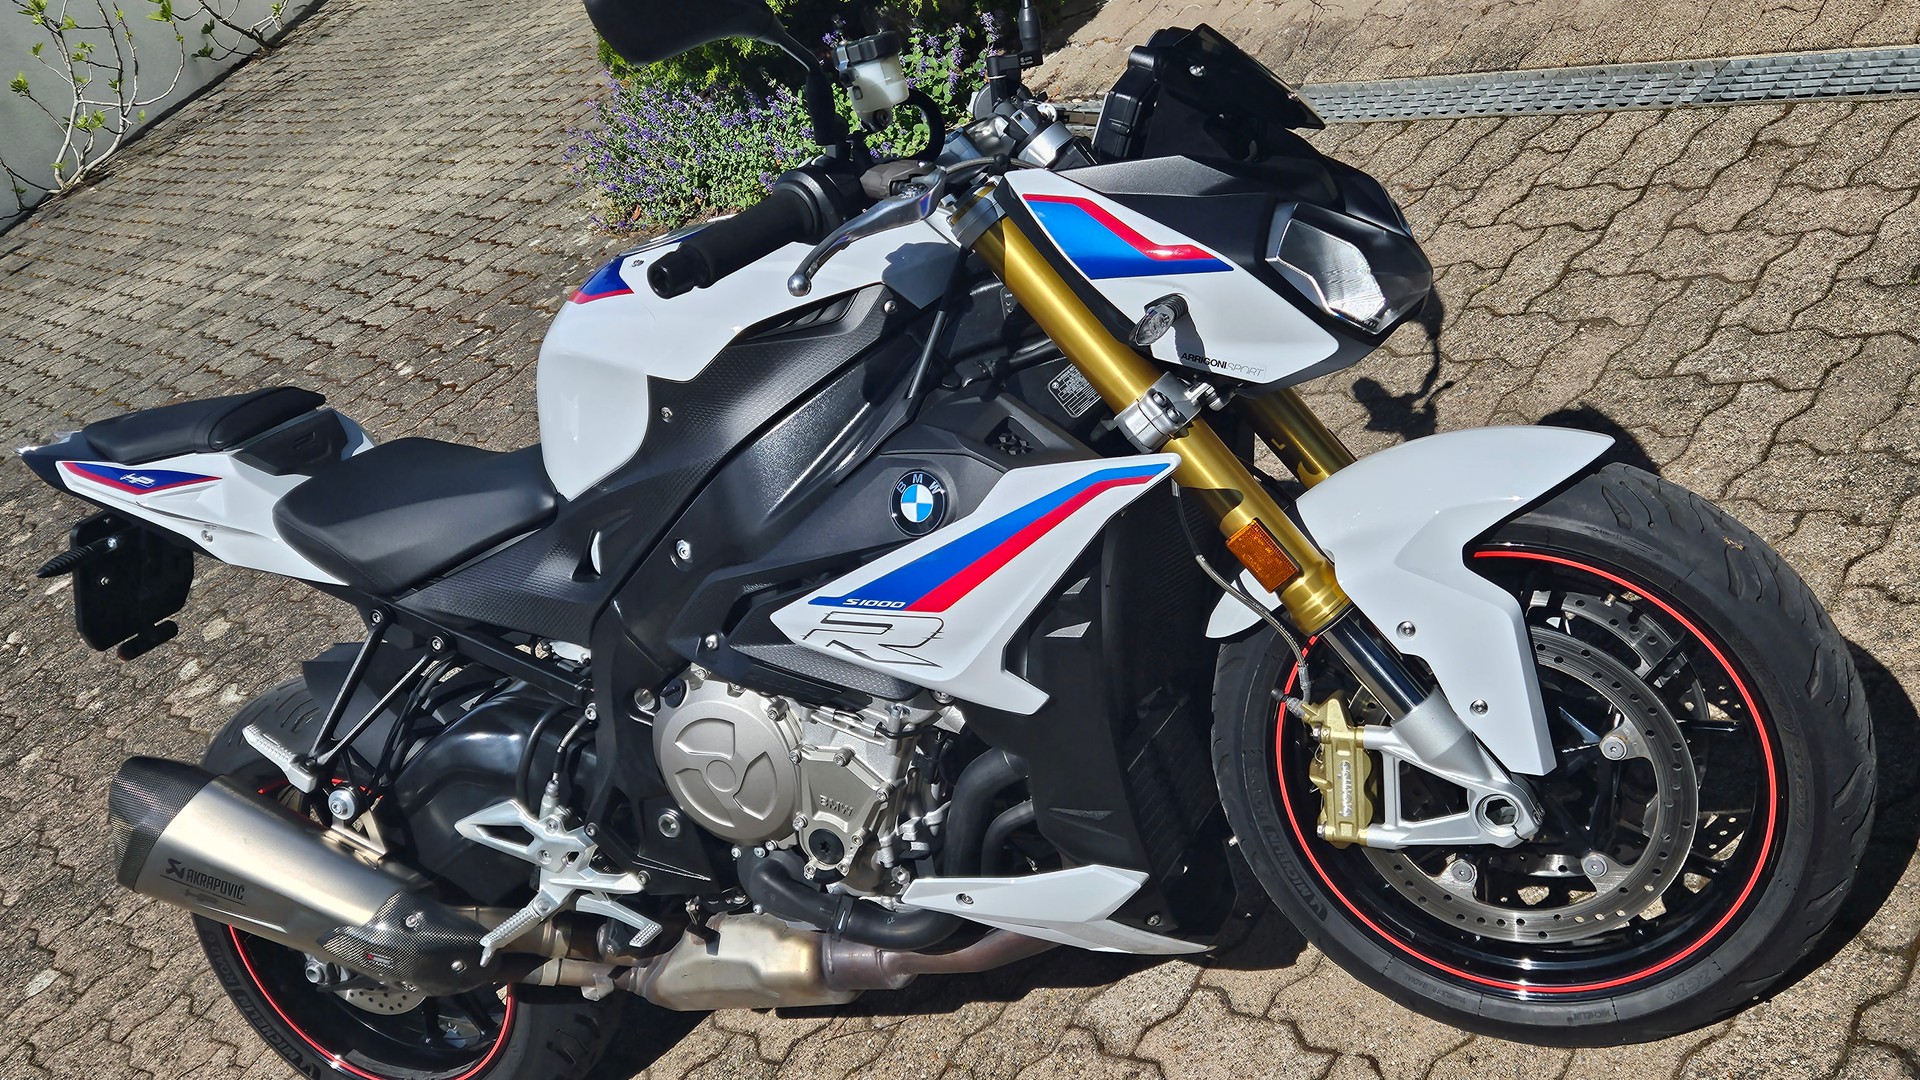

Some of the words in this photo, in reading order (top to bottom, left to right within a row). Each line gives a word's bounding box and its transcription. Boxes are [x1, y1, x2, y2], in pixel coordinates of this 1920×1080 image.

[1181, 352, 1228, 370] ARRIGONI
[896, 473, 940, 495] BMW
[843, 598, 906, 609] S1000
[802, 611, 945, 668] R
[818, 794, 854, 816] BMW
[209, 947, 237, 987] ROAD
[238, 995, 299, 1062] MICHELIN
